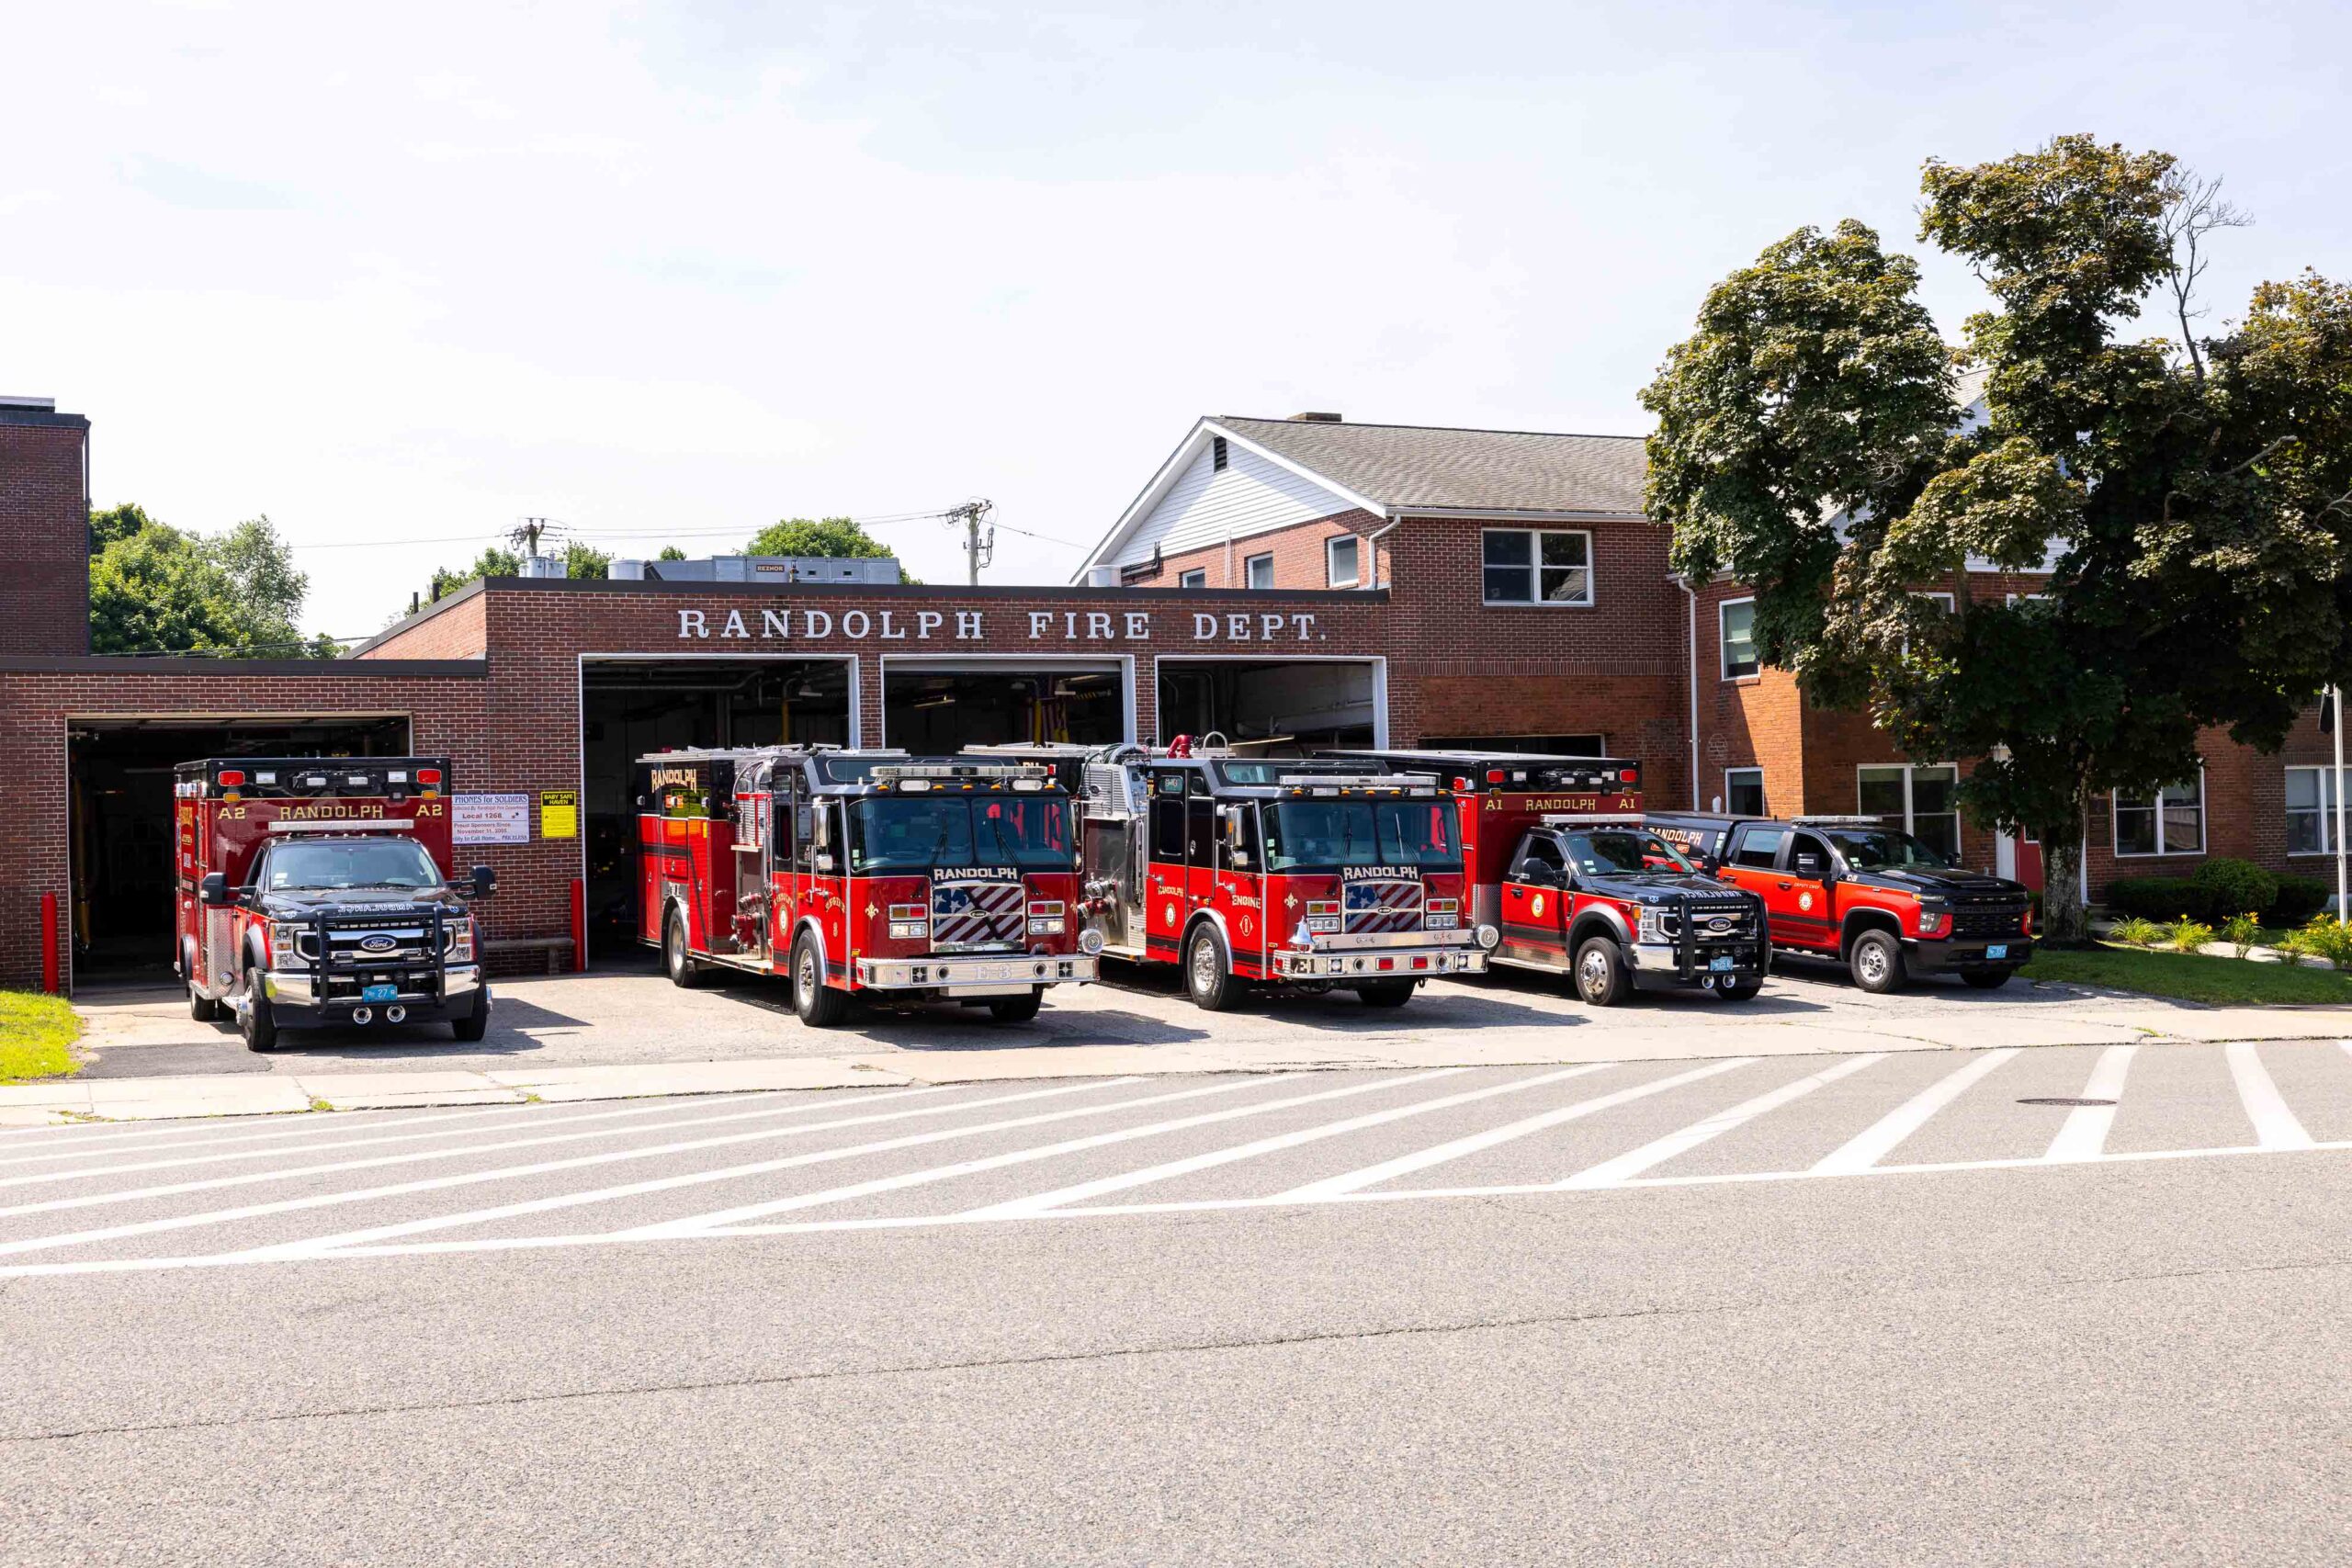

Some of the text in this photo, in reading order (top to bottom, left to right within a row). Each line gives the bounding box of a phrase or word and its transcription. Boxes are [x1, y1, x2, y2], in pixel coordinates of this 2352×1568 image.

[678, 609, 1327, 640] RANDOLPH FIRE DEPT.
[650, 768, 697, 794] RANDOLPH
[455, 795, 482, 804] PHONES
[484, 795, 494, 804] for
[1485, 798, 1635, 811] A1 RANDOLPH A1
[218, 804, 443, 821] A2 RANDOLPH A2
[933, 867, 1018, 881] RANDOLPH
[1342, 866, 1419, 881] RANDOLPH
[1232, 895, 1261, 909] ENGINE
[369, 939, 388, 949] Ford
[1296, 958, 1317, 974] E1
